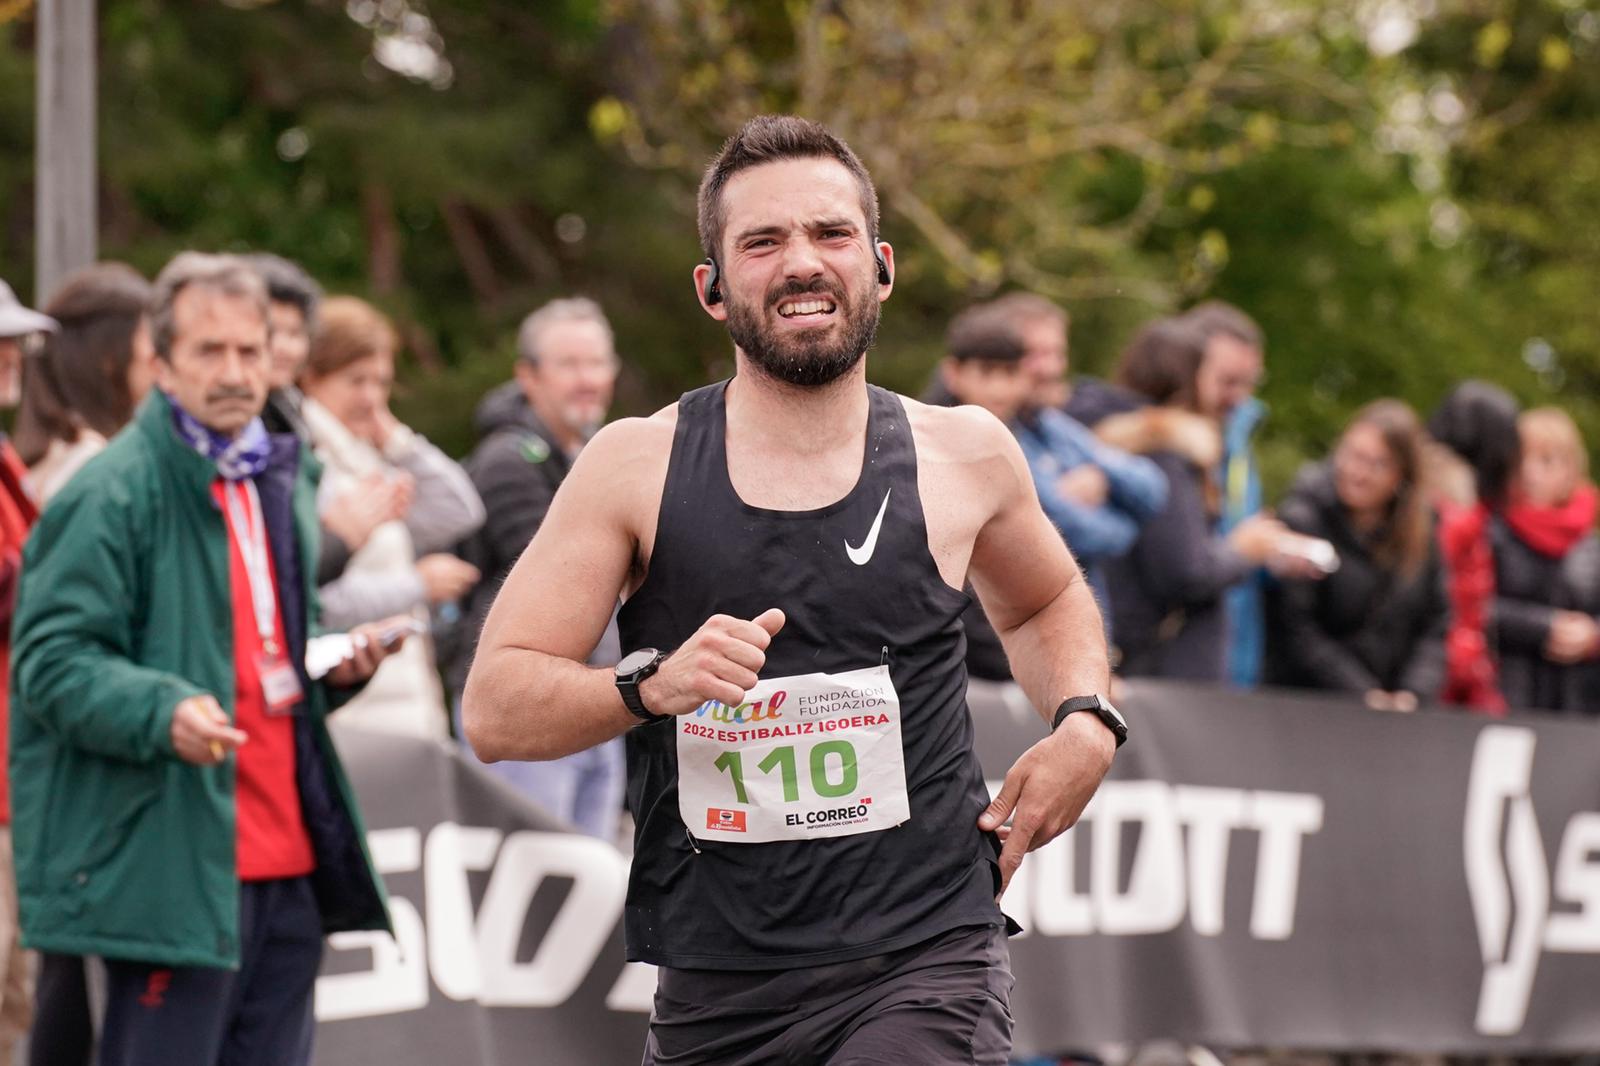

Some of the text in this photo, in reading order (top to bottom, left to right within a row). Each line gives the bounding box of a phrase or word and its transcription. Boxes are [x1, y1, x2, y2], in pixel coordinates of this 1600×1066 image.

[683, 713, 890, 742] 2022 ESTIBALIZ IGOERA
[800, 698, 887, 716] FUNDAZIOA
[714, 739, 858, 804] 110
[785, 805, 868, 826] EL CORREO
[985, 780, 1324, 940] COTT
[314, 821, 658, 1022] SCO
